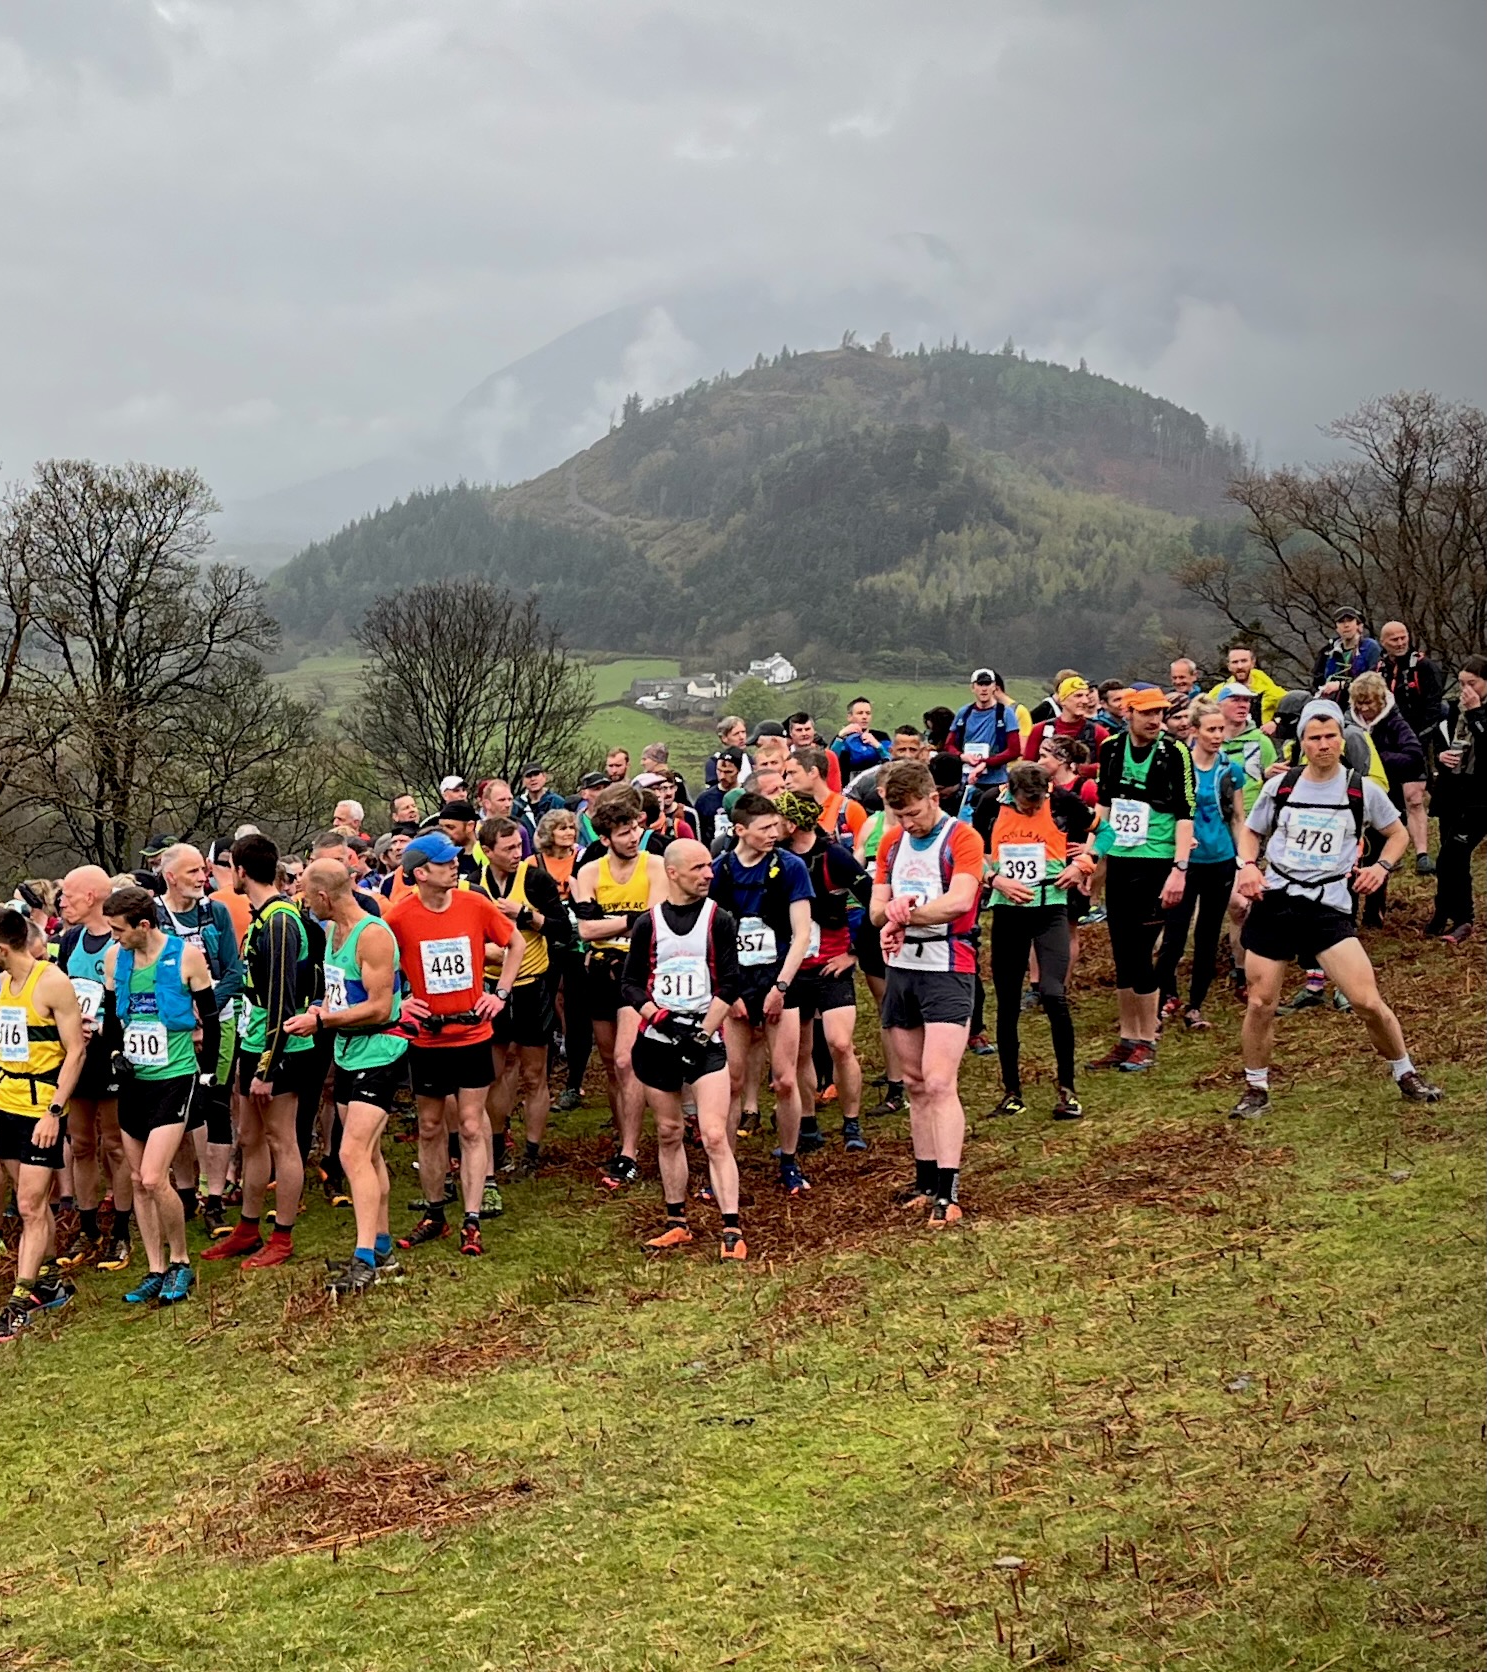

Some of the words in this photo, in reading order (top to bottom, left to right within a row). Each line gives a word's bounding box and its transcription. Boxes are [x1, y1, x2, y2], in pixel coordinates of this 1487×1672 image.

[1116, 814, 1140, 833] 523
[1296, 829, 1333, 853] 478
[1005, 860, 1037, 879] 393
[431, 954, 465, 977] 448
[661, 975, 693, 996] 311
[130, 1034, 159, 1055] 510
